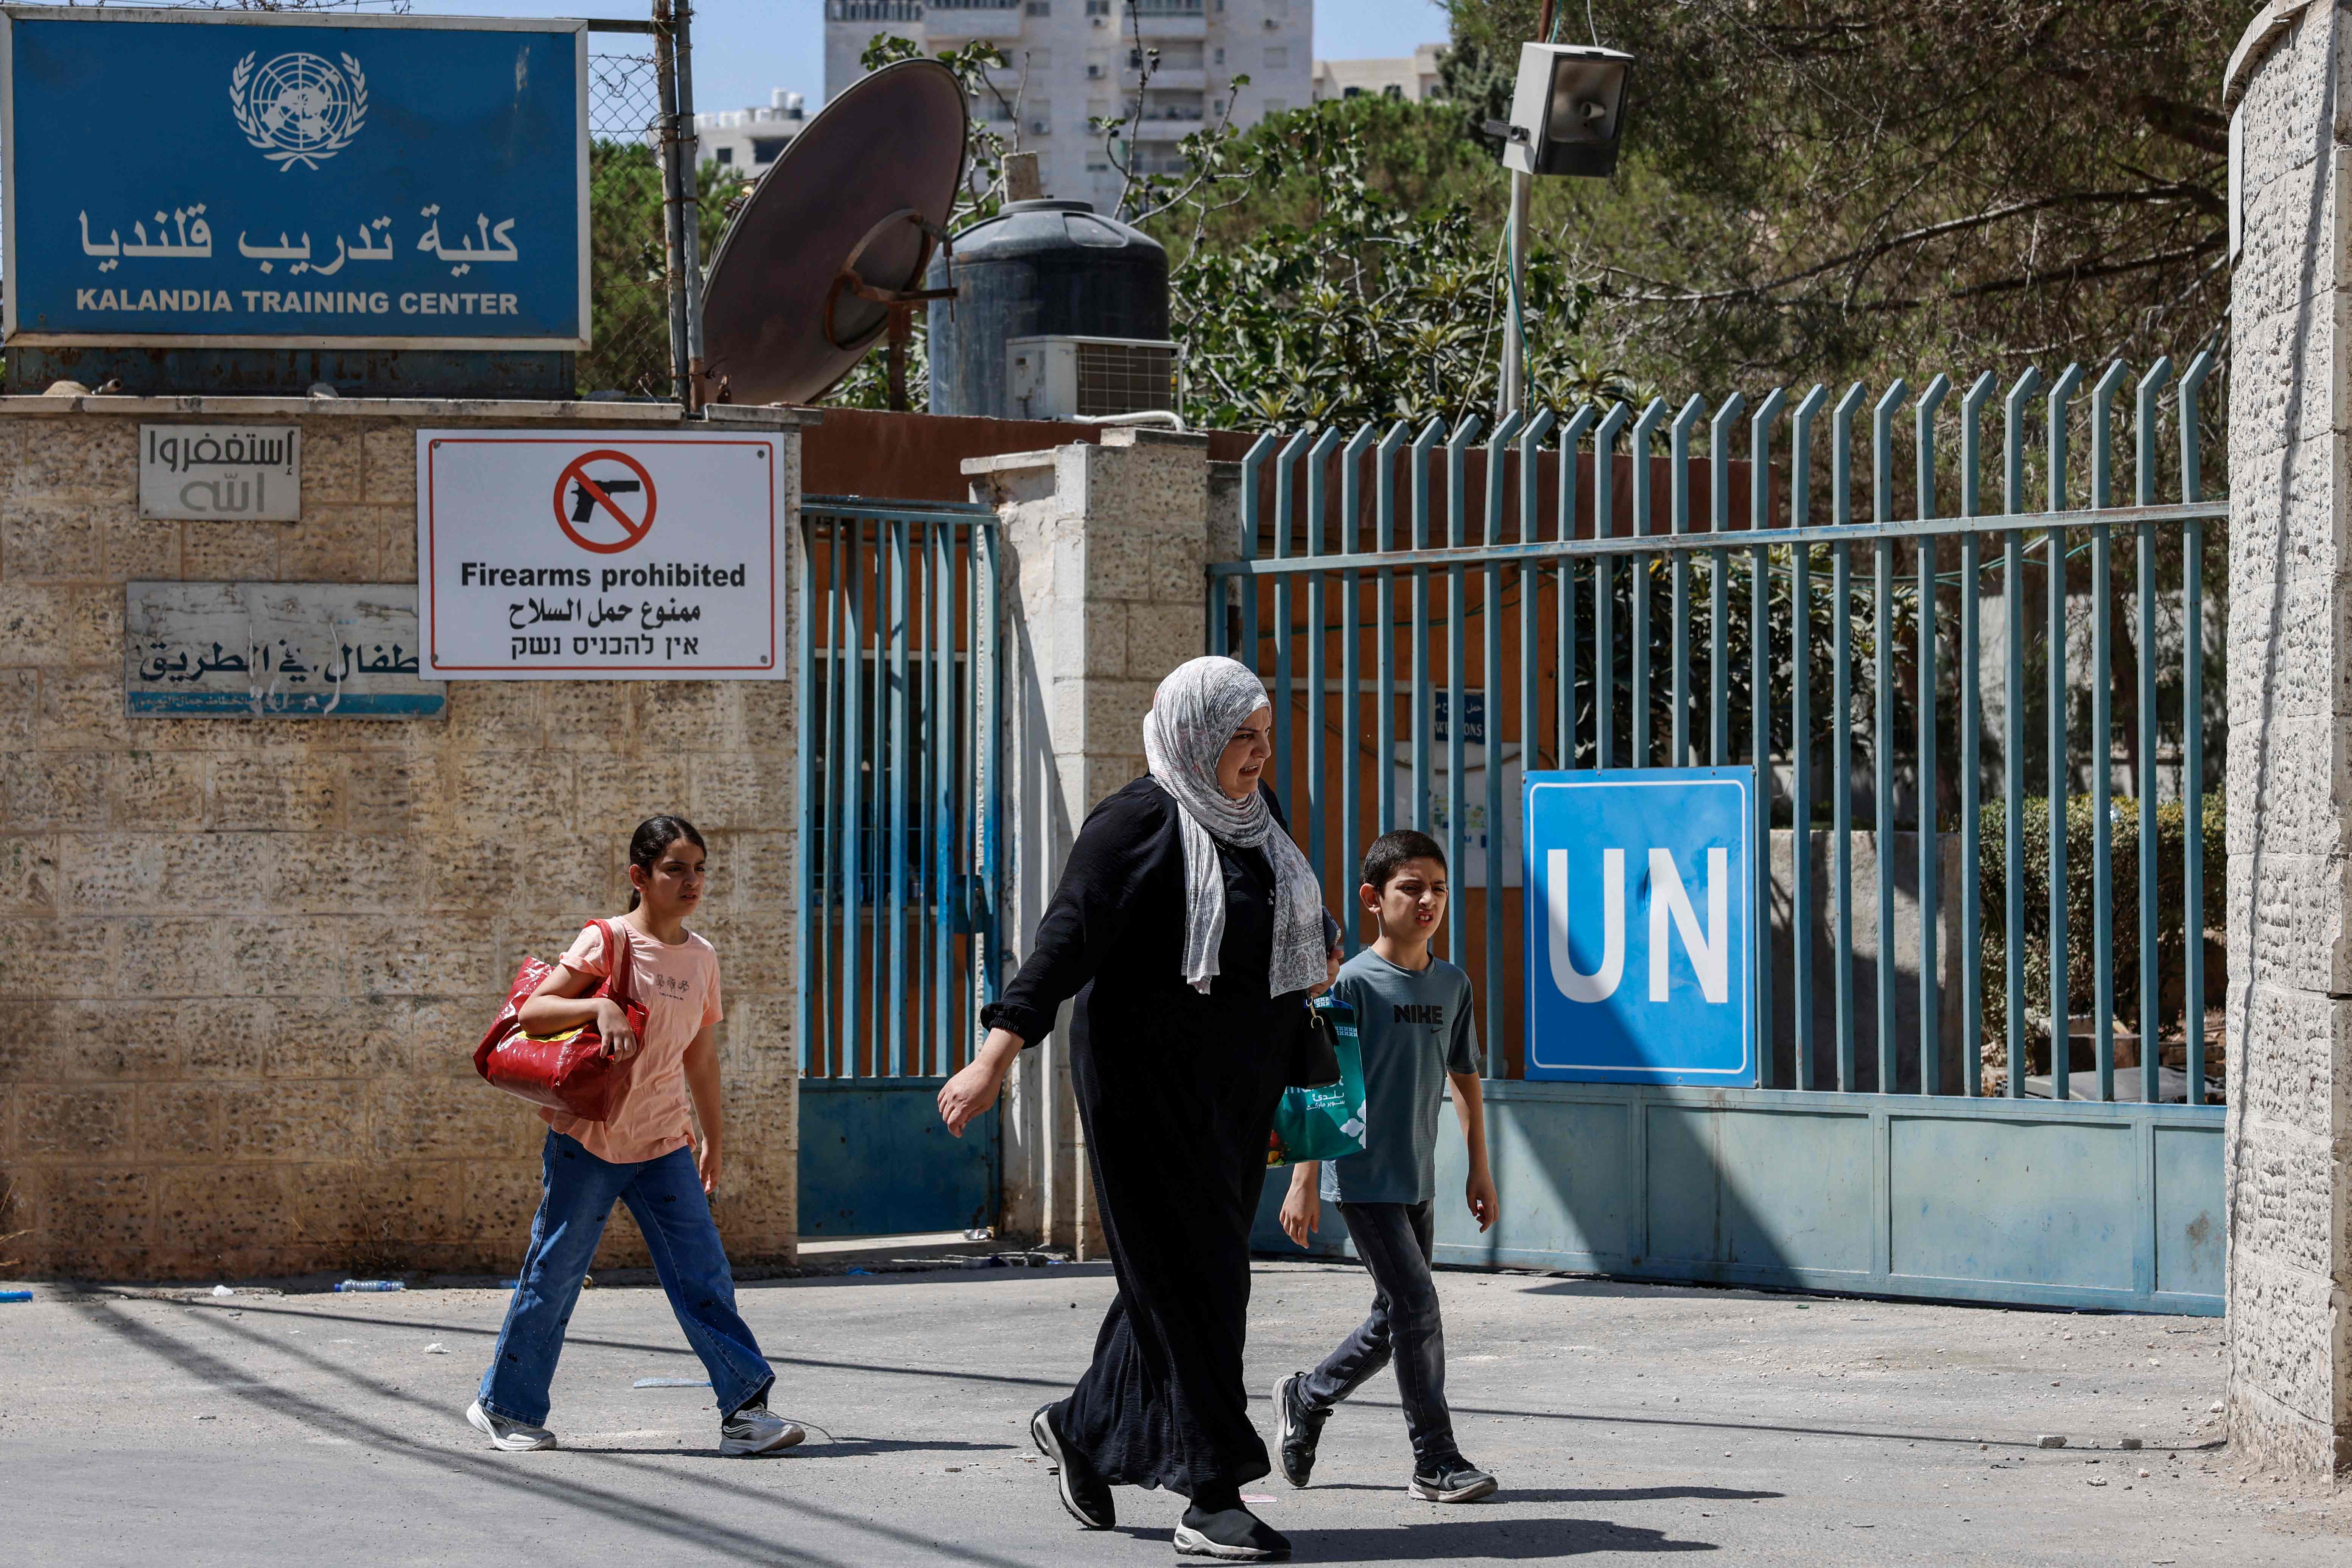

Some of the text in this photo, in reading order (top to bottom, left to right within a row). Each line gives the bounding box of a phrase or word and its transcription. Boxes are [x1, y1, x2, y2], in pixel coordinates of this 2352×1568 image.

[79, 203, 517, 277] كلية تدريب قلنديا
[77, 289, 518, 315] KALANDIA TRAINING CENTER
[150, 430, 293, 475] إستغفروا
[180, 472, 264, 512] الله
[462, 562, 745, 592] Firearms prohibited
[509, 598, 700, 630] ممنوع حمل السلاح
[512, 634, 698, 660] אין להכניס נשק
[1435, 721, 1482, 737] WONS
[1547, 847, 1728, 1004] UN
[1393, 1004, 1444, 1025] NIKE
[1312, 1090, 1344, 1102] بلدي
